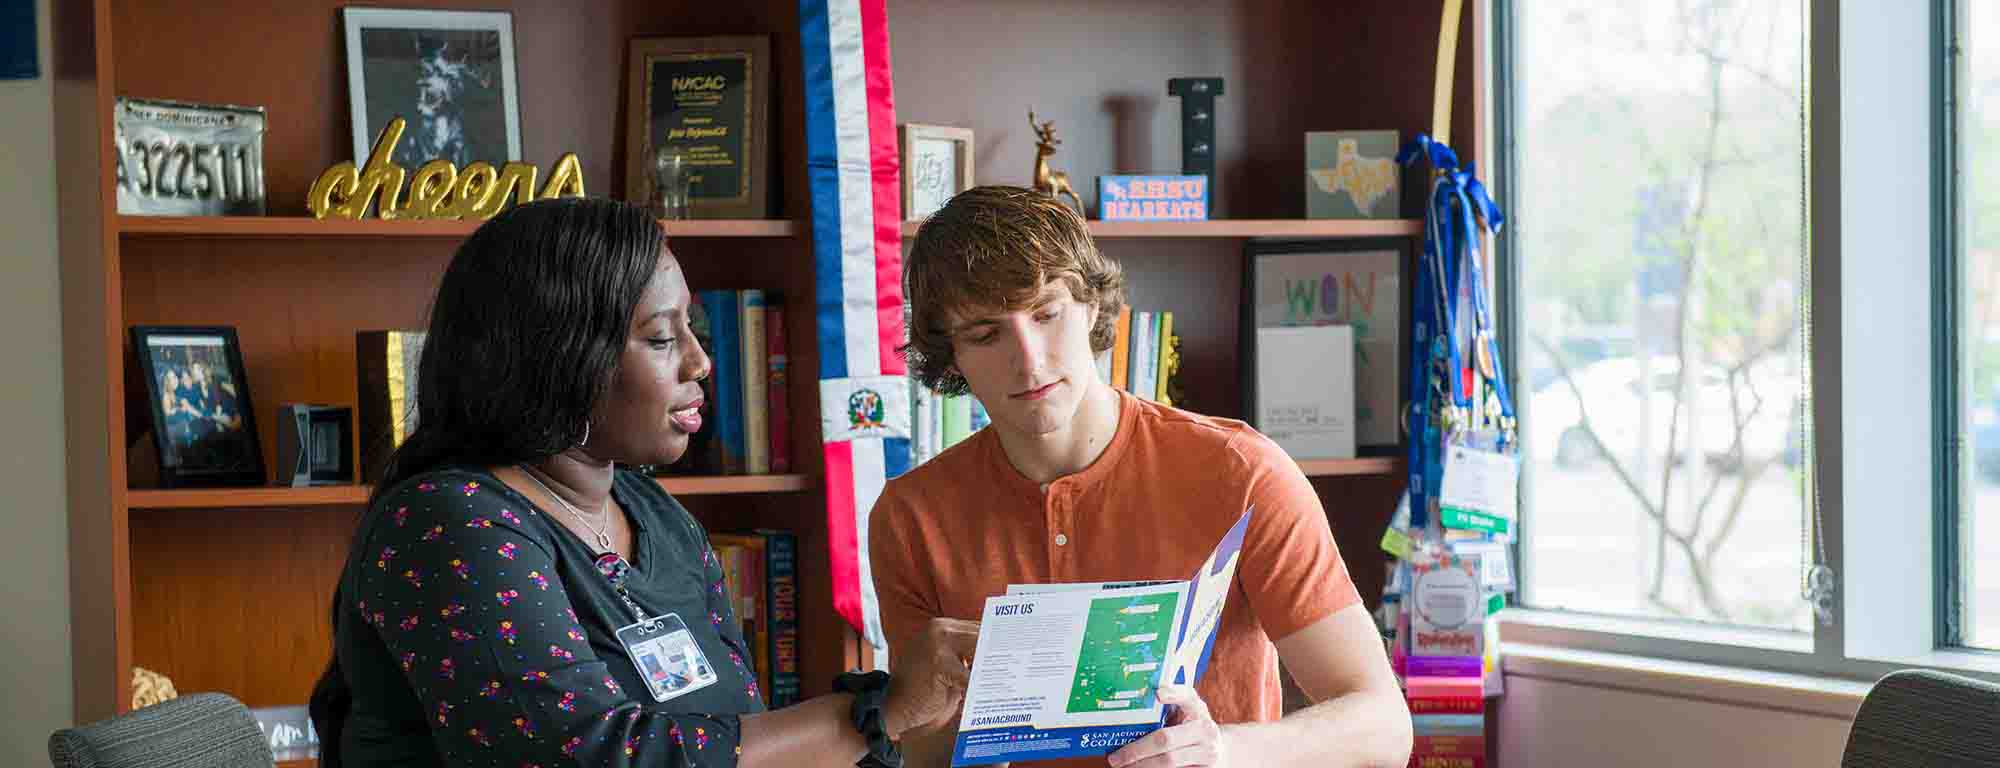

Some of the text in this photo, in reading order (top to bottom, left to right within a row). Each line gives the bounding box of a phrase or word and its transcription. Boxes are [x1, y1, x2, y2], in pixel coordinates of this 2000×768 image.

[672, 76, 726, 90] NACAC
[307, 117, 586, 220] cheers
[995, 603, 1035, 616] VISIT US
[971, 714, 1032, 727] #SANJACBOUND
[1090, 737, 1136, 748] COLLE
[1110, 731, 1145, 741] JACINTO
